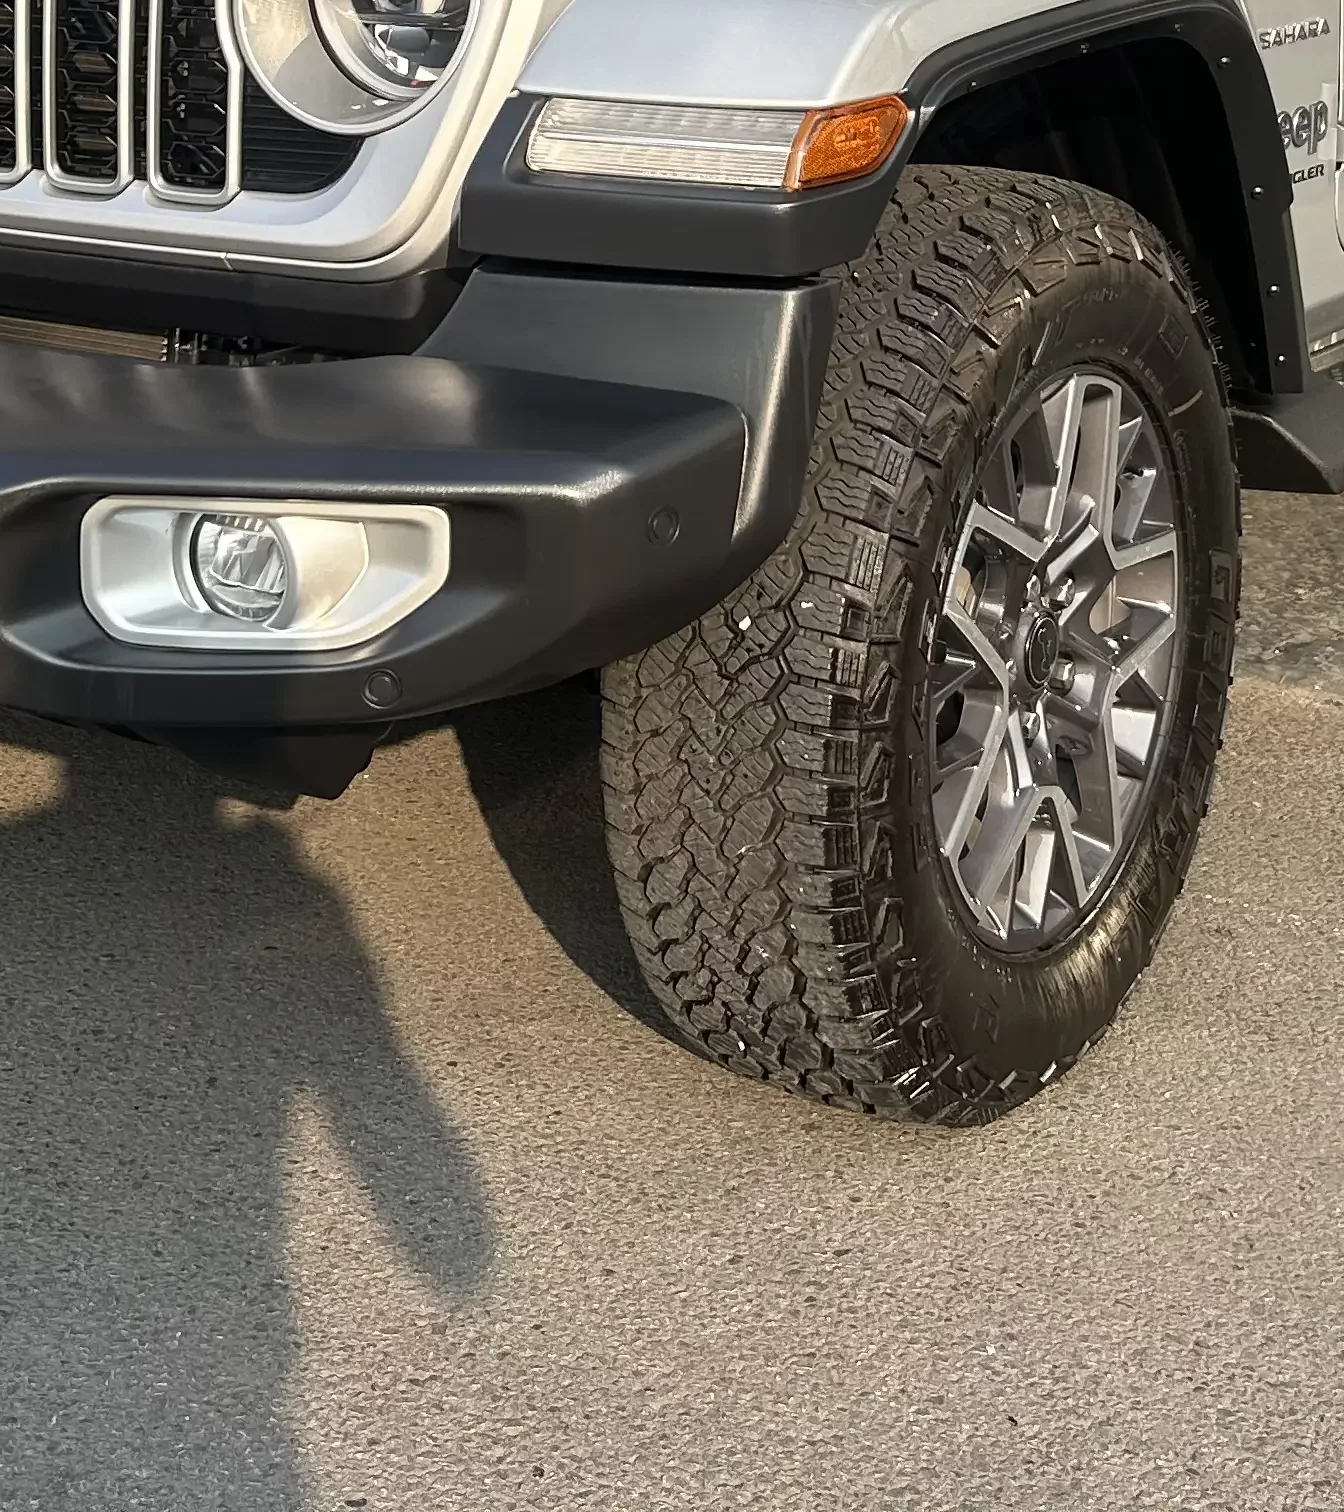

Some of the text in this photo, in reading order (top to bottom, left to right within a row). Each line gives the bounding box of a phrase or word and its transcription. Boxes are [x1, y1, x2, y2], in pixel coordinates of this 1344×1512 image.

[1257, 17, 1331, 50] SAHARA
[1276, 100, 1329, 156] eep
[1290, 163, 1325, 185] GLER
